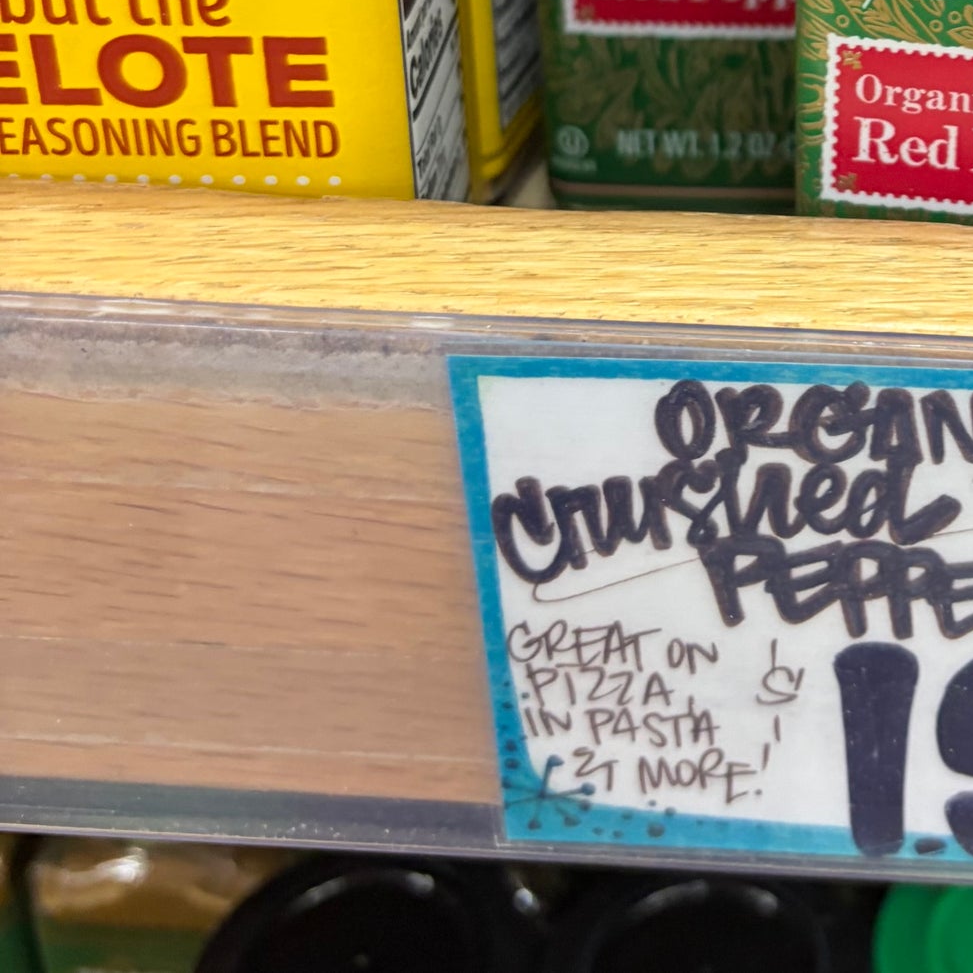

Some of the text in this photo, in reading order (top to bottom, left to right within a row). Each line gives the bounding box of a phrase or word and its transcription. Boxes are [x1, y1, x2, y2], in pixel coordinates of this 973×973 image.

[0, 116, 341, 159] EASONING BLEND
[851, 116, 960, 172] Red
[491, 447, 960, 585] Crushed
[506, 618, 719, 675] GREAT ON
[523, 705, 721, 749] IN PASTA
